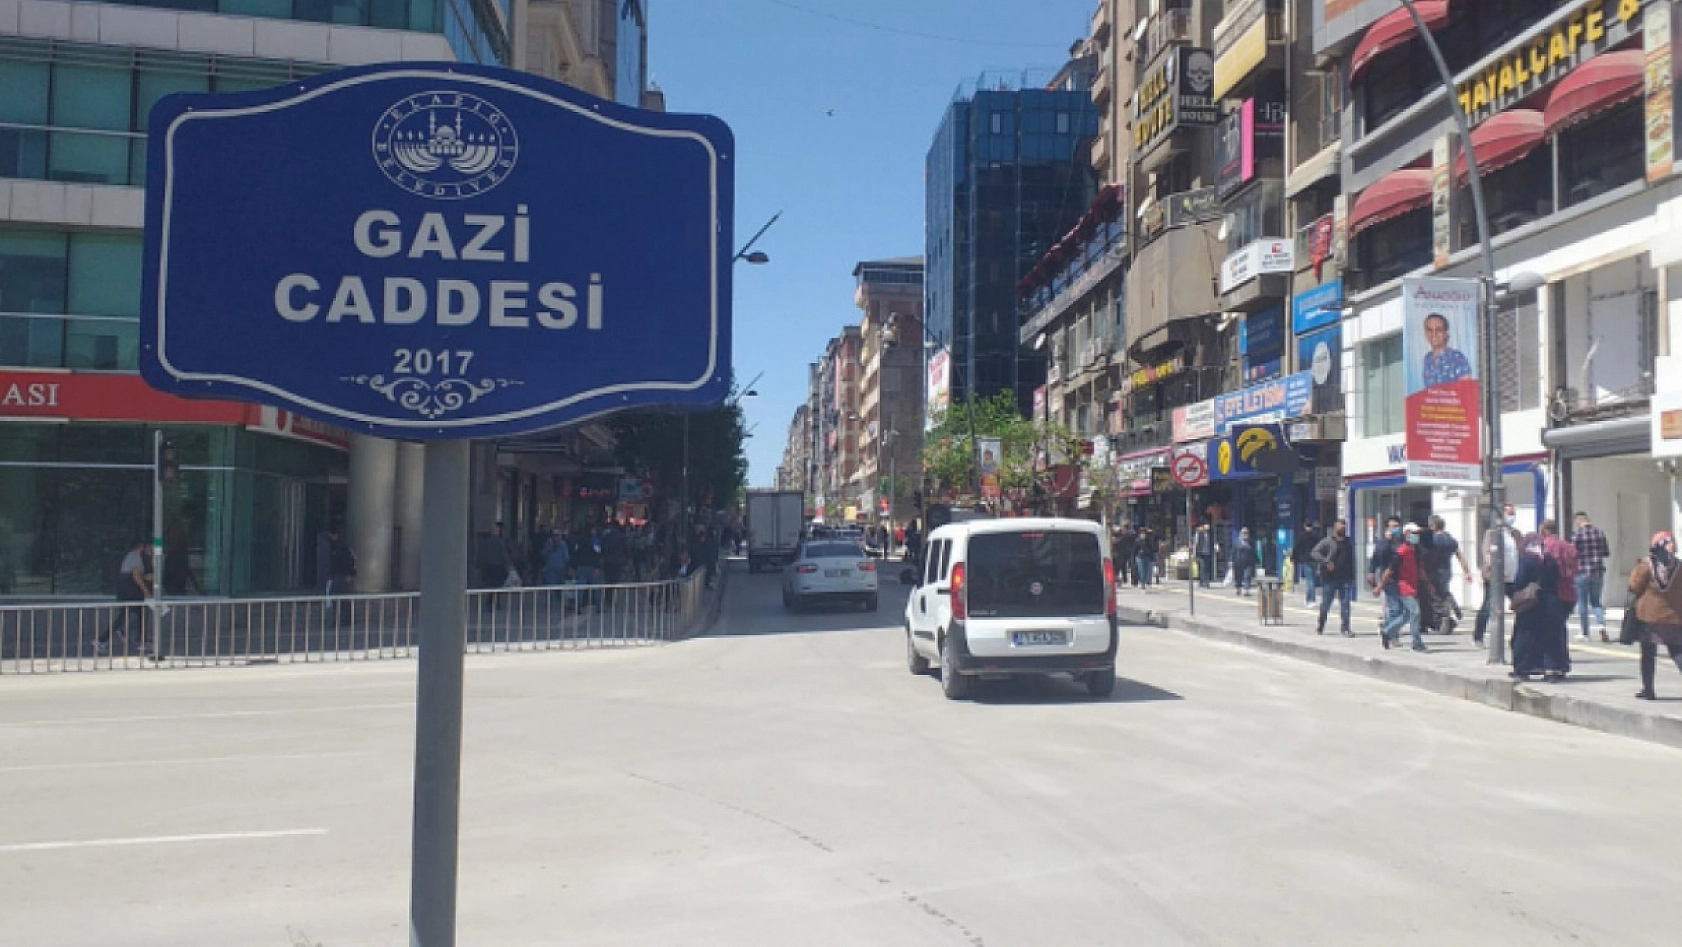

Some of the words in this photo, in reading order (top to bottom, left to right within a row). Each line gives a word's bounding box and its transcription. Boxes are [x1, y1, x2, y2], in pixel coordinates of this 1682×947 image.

[353, 203, 530, 263] GAZİ
[275, 273, 603, 330] CADDESİ
[393, 349, 474, 376] 2017
[1, 383, 60, 406] ASI
